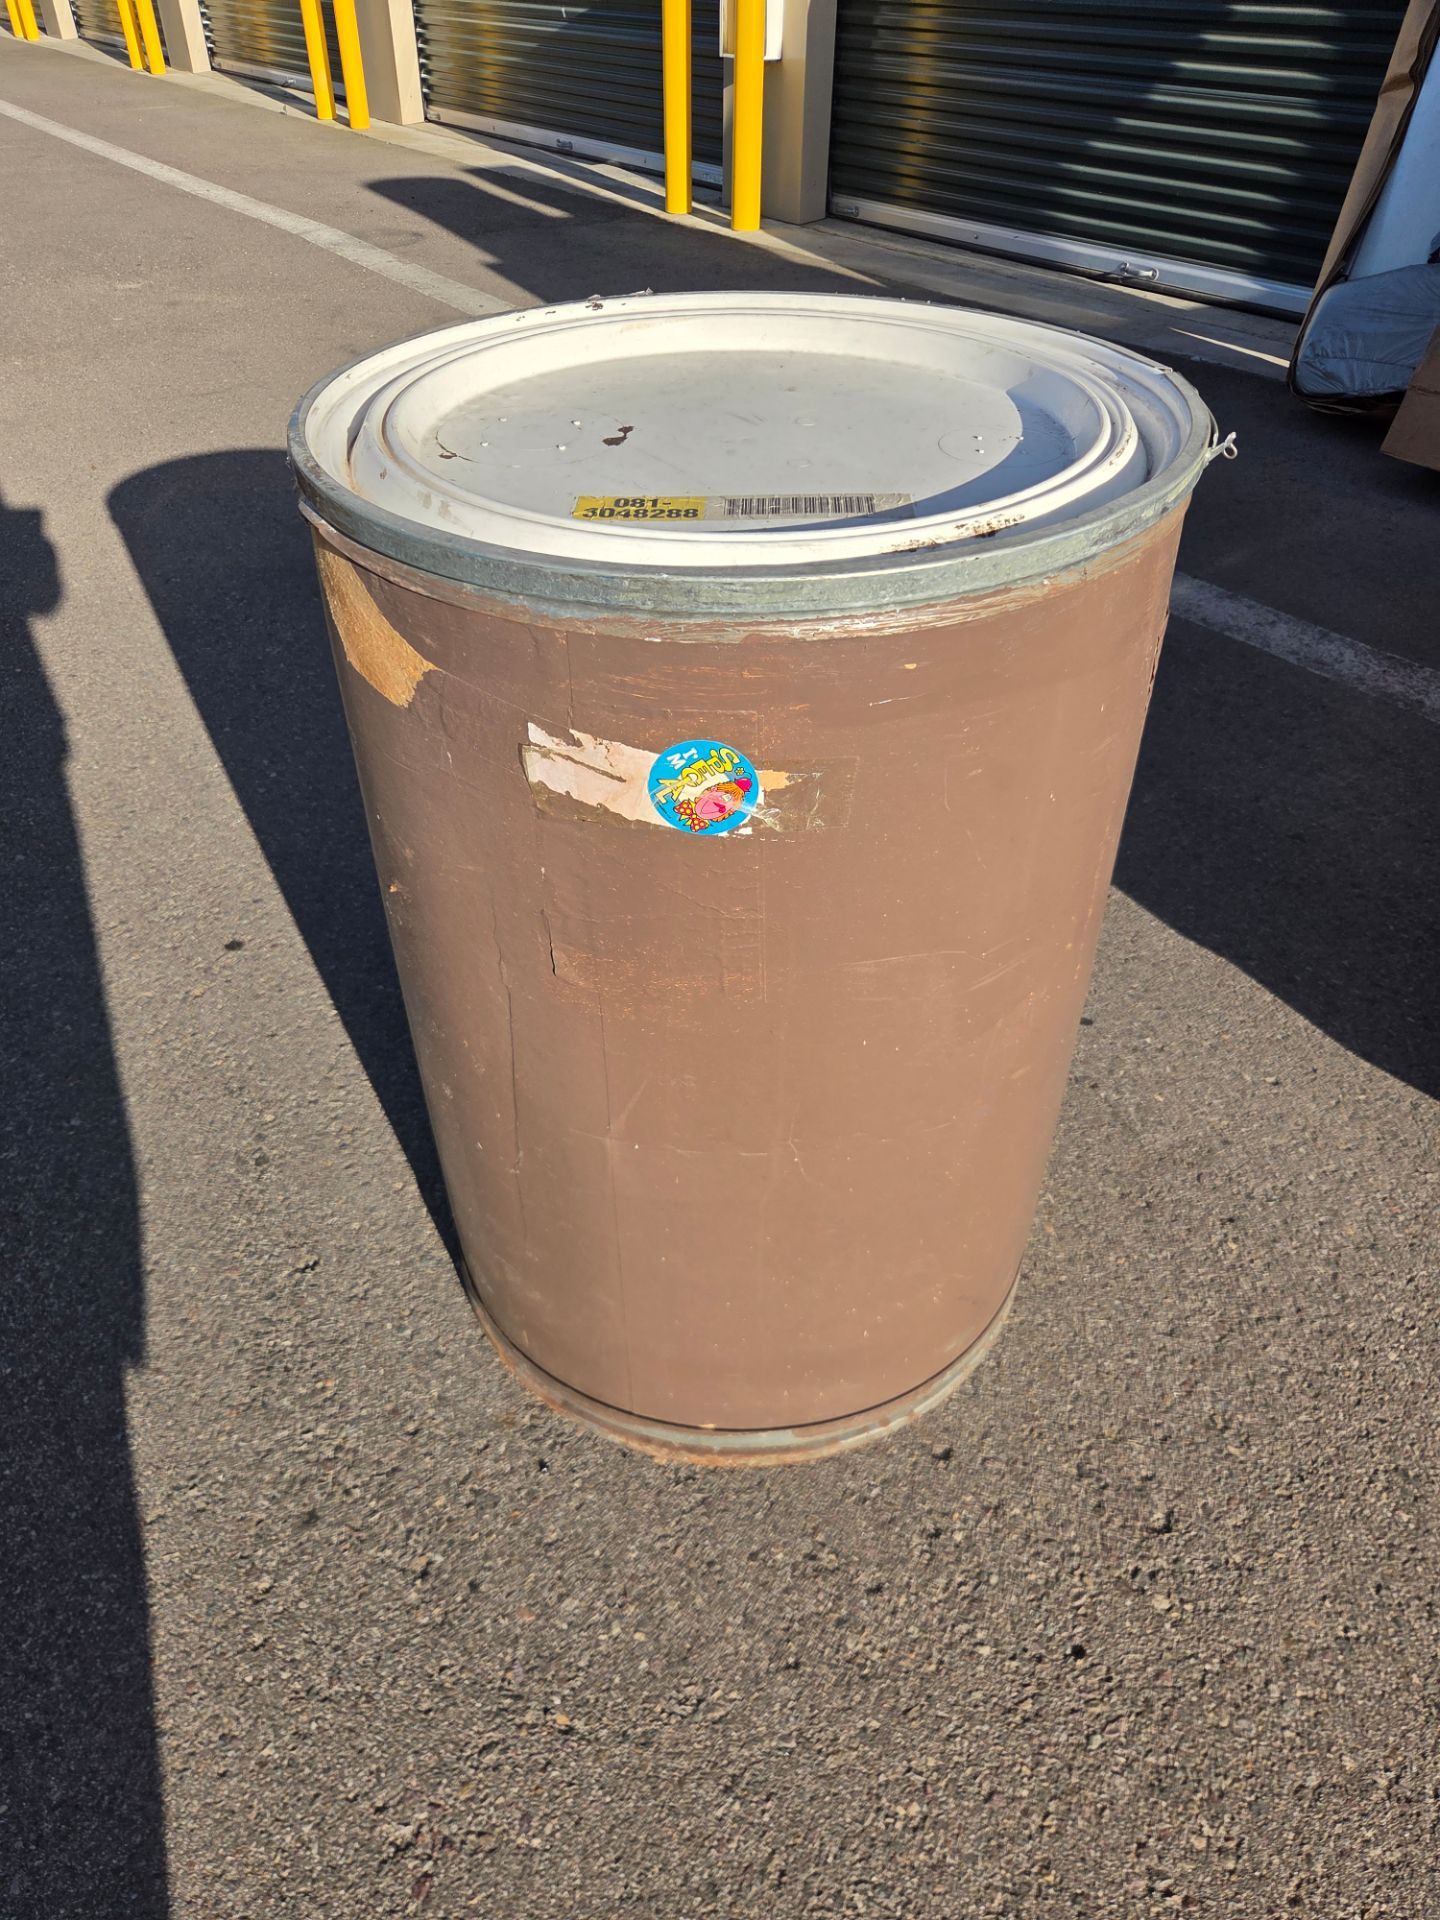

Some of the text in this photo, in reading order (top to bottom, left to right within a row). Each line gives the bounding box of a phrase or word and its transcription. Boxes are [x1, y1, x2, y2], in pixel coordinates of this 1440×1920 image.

[613, 498, 672, 508] 081-
[582, 508, 699, 519] 3048288
[666, 747, 699, 771] I'M
[655, 747, 741, 804] SPECIAL
